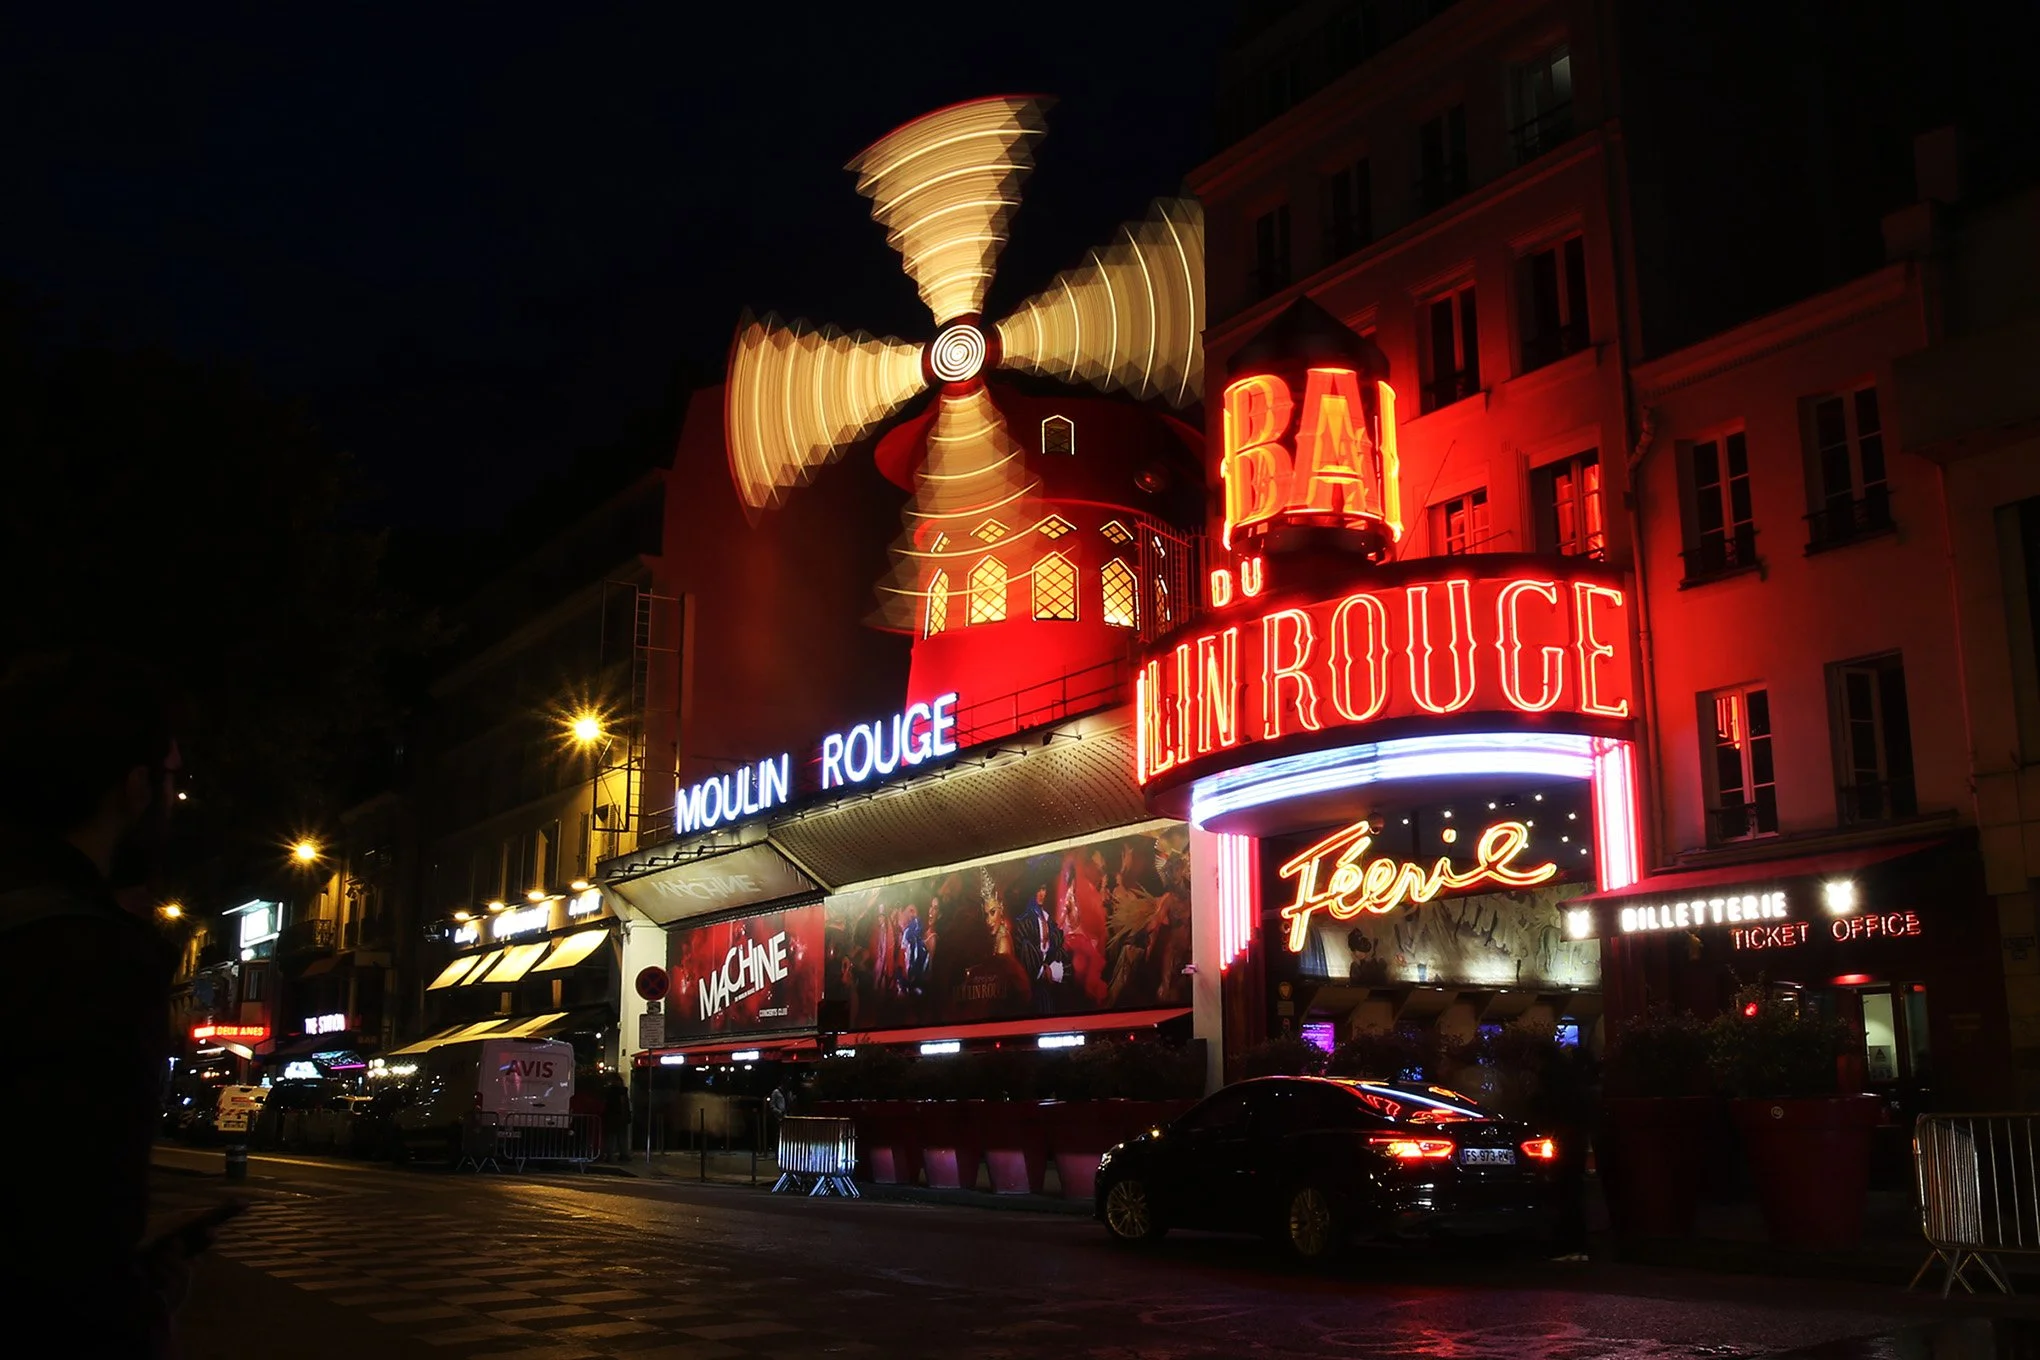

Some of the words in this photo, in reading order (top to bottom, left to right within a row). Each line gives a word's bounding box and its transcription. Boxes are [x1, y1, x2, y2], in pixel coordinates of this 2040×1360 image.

[1211, 557, 1261, 607] DU
[1262, 579, 1628, 739] ROUGE
[676, 753, 788, 834] MOULIN
[822, 692, 959, 790] ROUGE
[1280, 820, 1556, 952] Féerie
[1622, 892, 1787, 932] BILLETTERIE
[1730, 922, 1809, 950] TICKET
[1831, 911, 1921, 942] OFFICE
[699, 931, 788, 1021] MACHINE
[506, 1060, 554, 1078] AVIS
